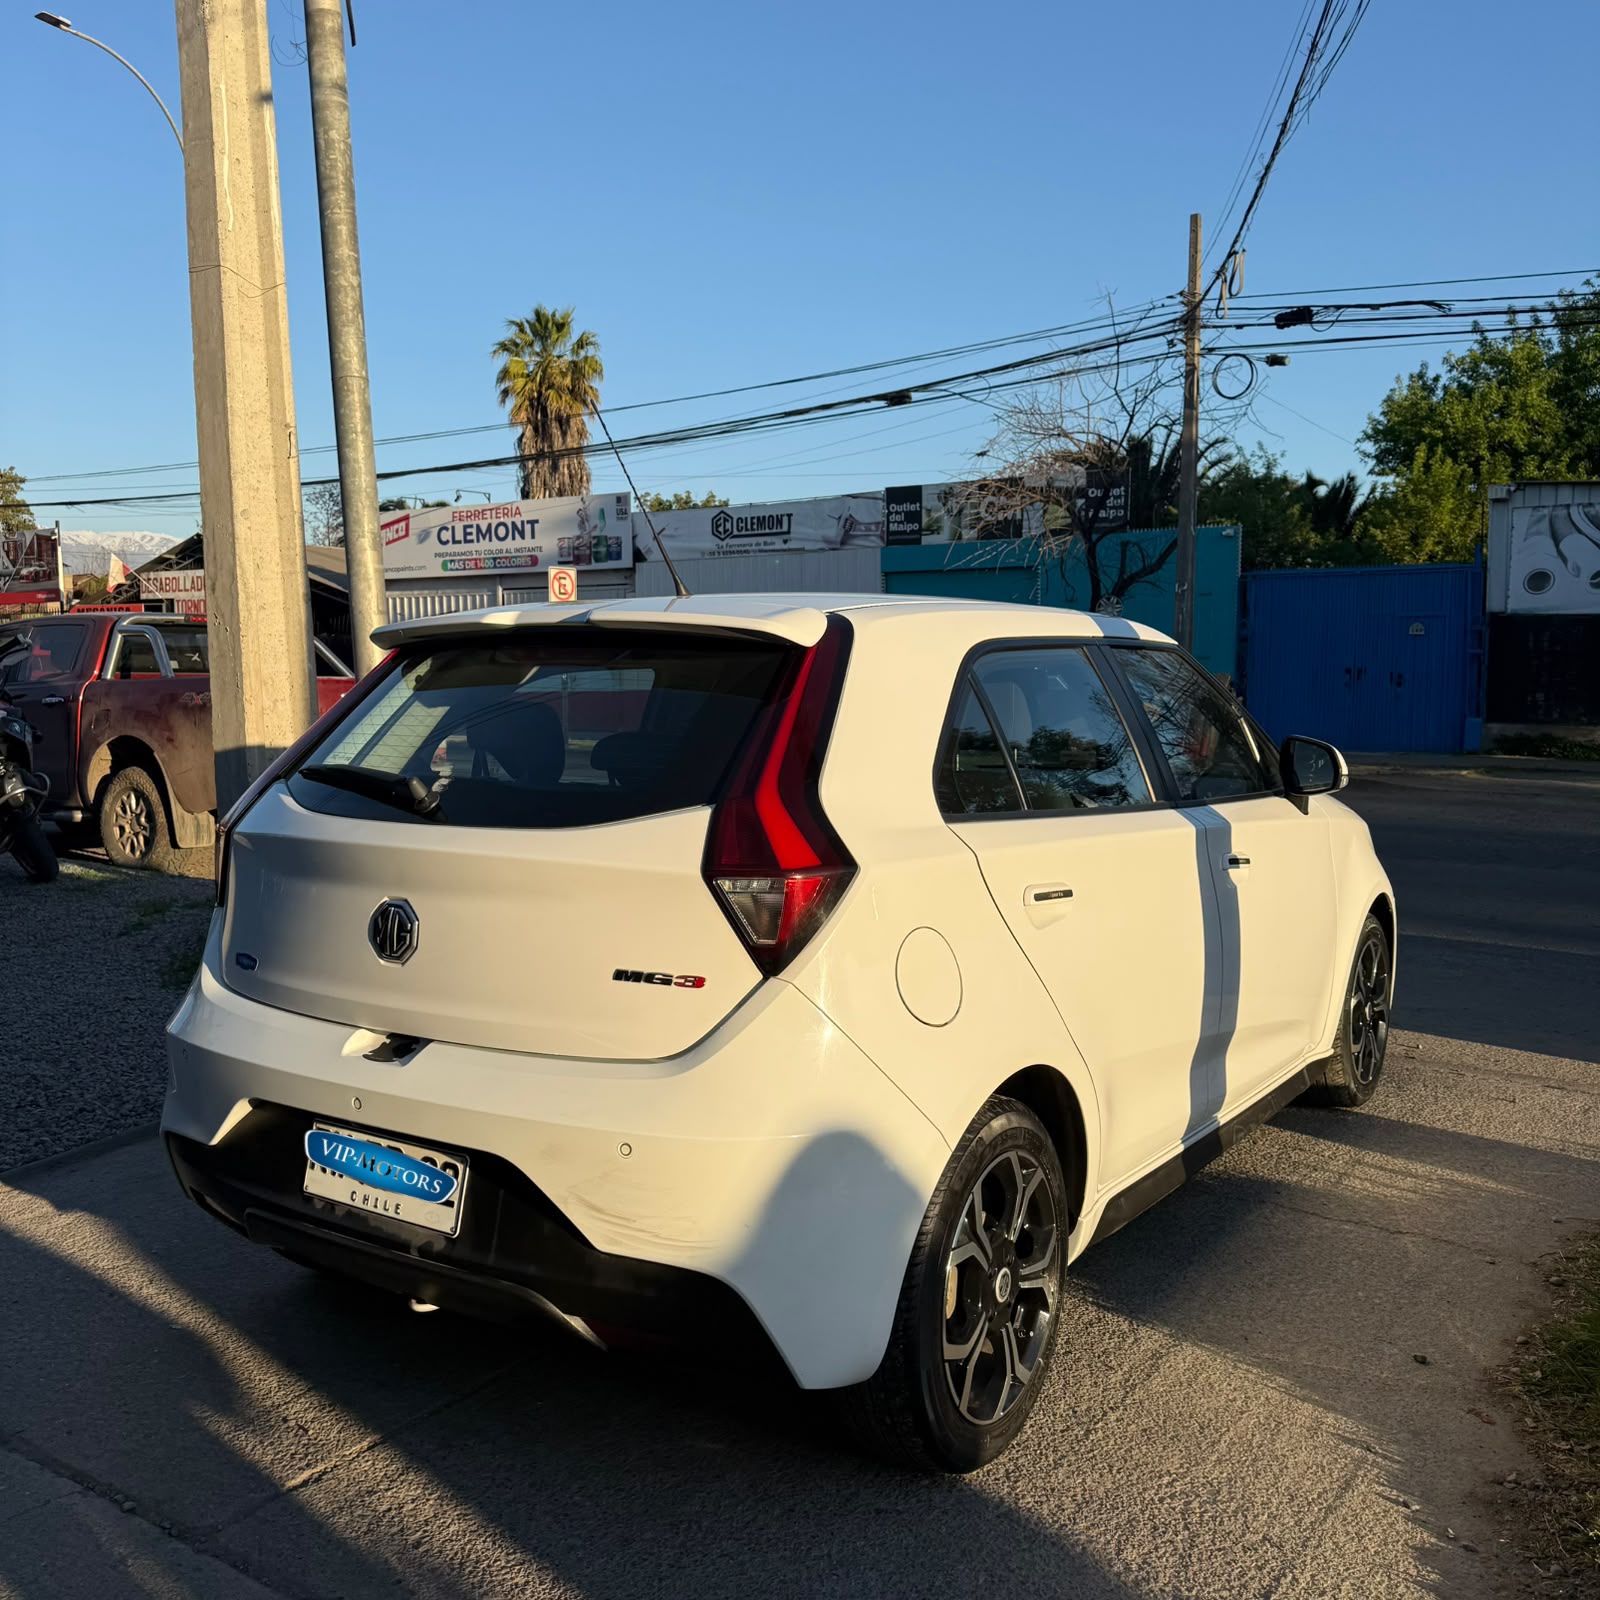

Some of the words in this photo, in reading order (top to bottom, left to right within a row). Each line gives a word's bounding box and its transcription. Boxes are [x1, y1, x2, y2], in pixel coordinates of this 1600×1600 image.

[451, 504, 522, 522] FERRETERÍA
[889, 501, 920, 512] Outlet
[735, 513, 794, 533] CLEMONT
[889, 512, 905, 522] del
[436, 519, 540, 546] CLEMONT
[889, 521, 920, 534] Maipo
[434, 550, 474, 559] PREPARAMOS
[483, 548, 504, 556] COLOR
[513, 545, 543, 554] INSTANTE
[465, 560, 476, 569] DE
[495, 557, 532, 568] COLORES
[141, 575, 206, 594] DESABOLLAD
[612, 968, 706, 989] MG3
[350, 1190, 403, 1215] CHILE
